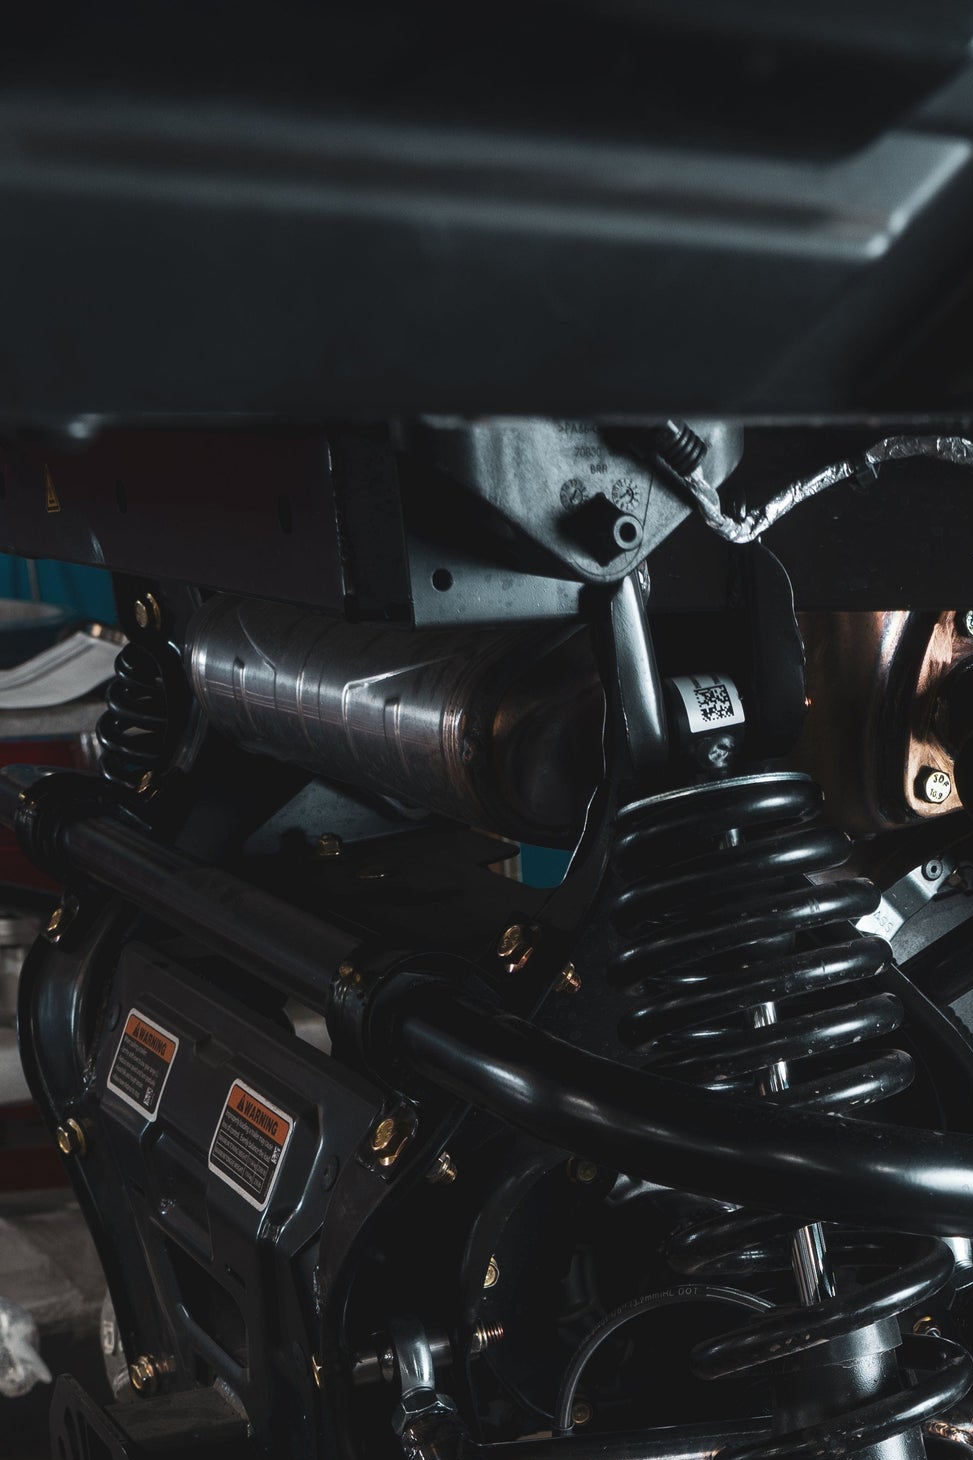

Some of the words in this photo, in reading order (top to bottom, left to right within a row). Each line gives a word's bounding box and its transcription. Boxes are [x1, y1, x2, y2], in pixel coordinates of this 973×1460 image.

[139, 1026, 167, 1057] WARNING
[244, 1100, 279, 1136] WARNING
[678, 1287, 698, 1296] DOT
